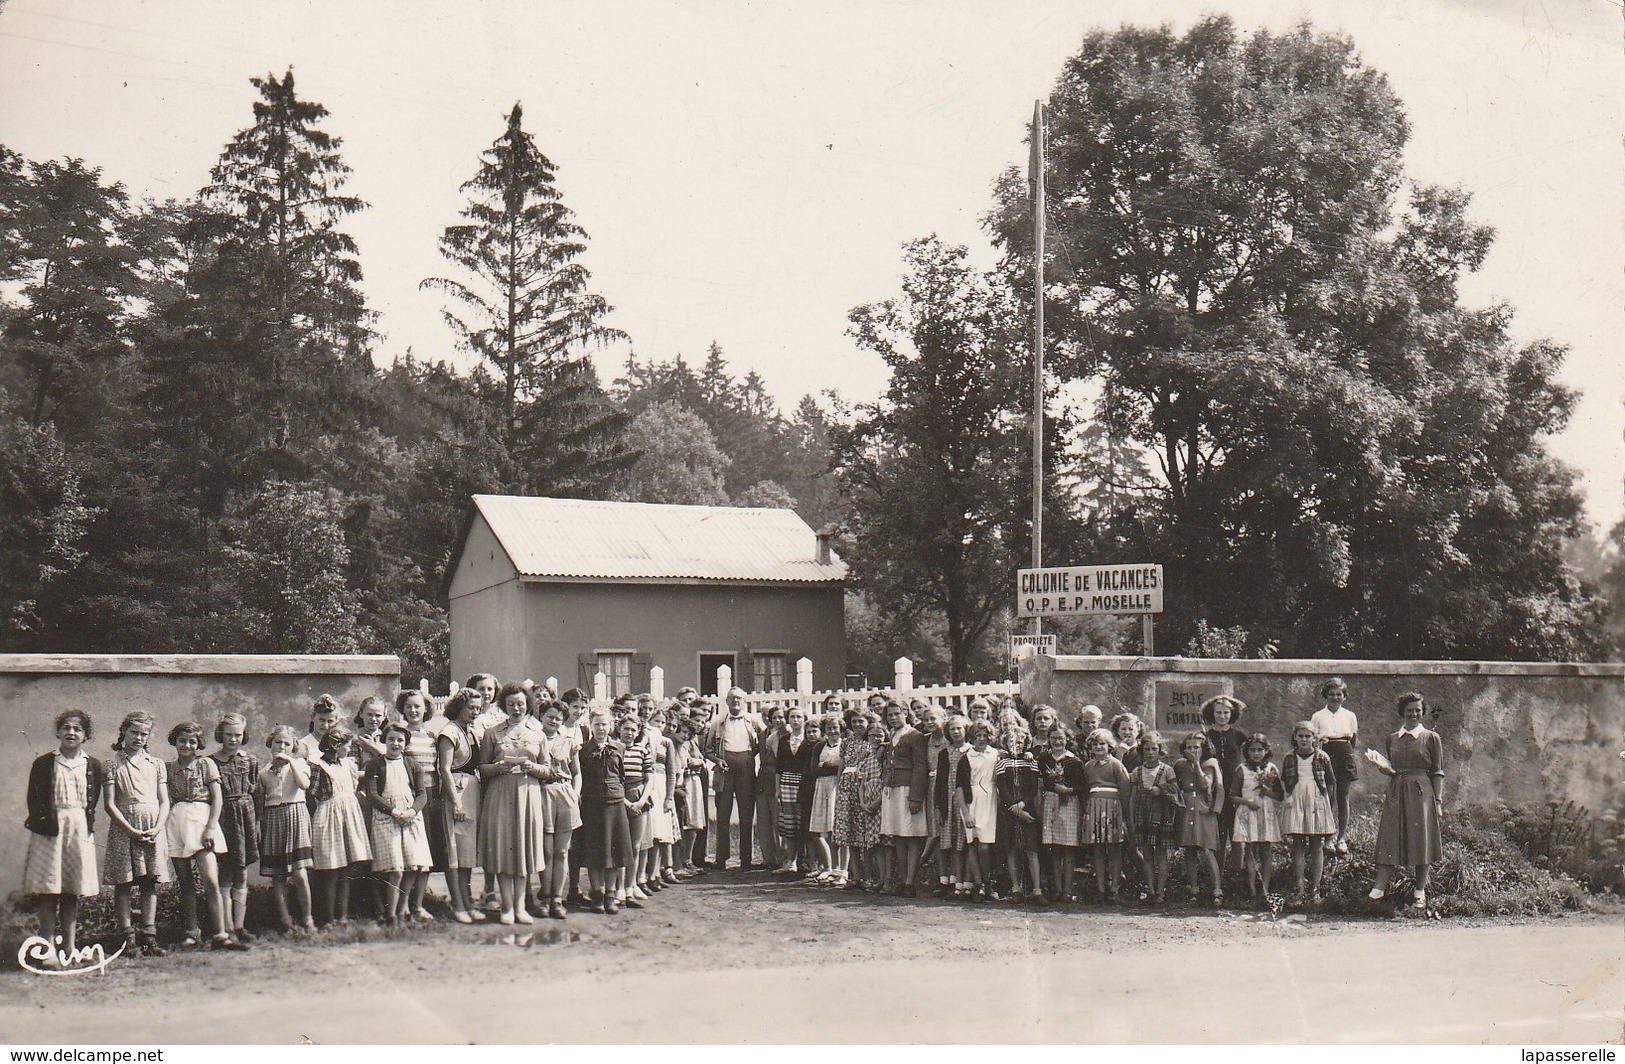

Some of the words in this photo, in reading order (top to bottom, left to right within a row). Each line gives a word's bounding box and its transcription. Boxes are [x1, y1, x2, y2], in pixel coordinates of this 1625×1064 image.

[1022, 572, 1069, 594] COLONIE
[1075, 575, 1090, 592] DE
[1092, 594, 1151, 611] MOSELLE
[1169, 691, 1204, 706] BELLE
